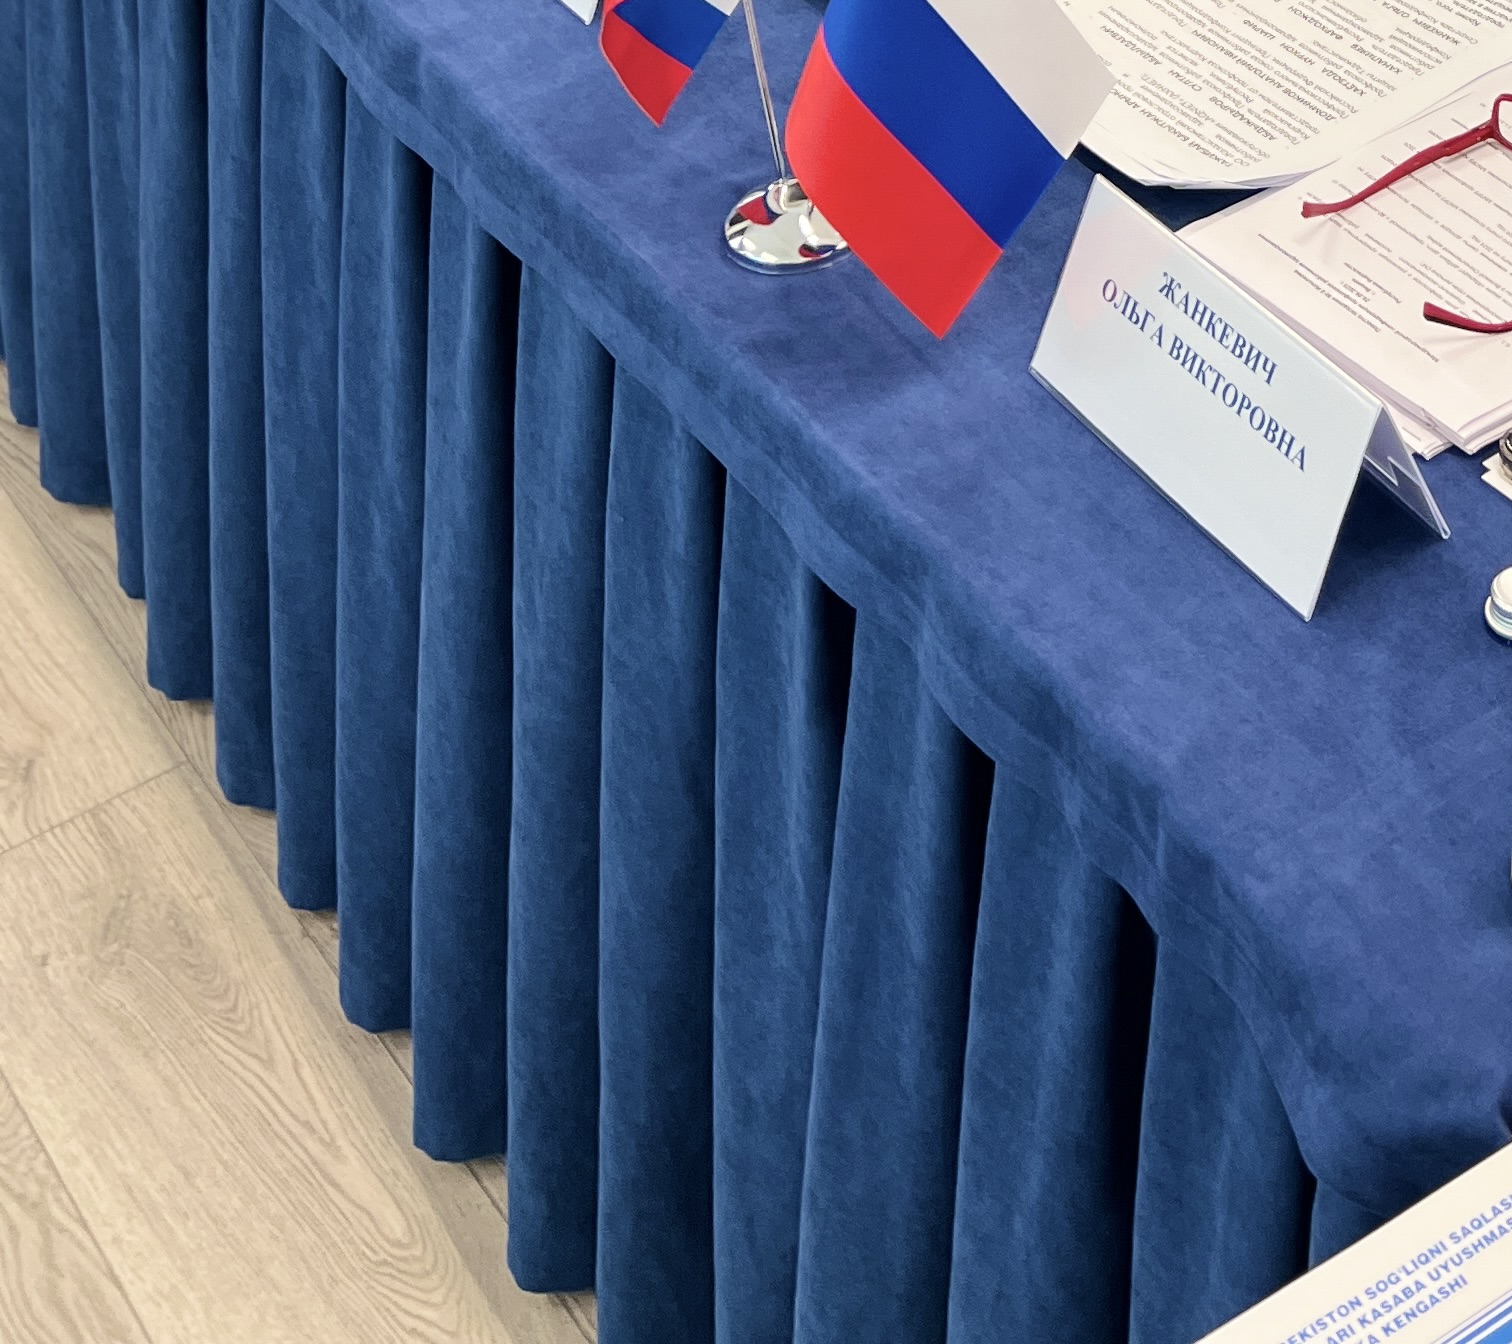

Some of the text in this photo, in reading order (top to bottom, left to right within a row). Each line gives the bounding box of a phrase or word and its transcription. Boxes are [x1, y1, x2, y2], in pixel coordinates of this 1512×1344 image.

[1157, 271, 1279, 386] ЖАНКЕВИЧ
[1100, 277, 1165, 351] ОЛЬГА
[1167, 334, 1307, 474] ВИКТОРОВНА
[1281, 1294, 1365, 1344] EKISTON
[1354, 1276, 1428, 1330] KASABA
[1356, 1272, 1472, 1344] A KENGASHI
